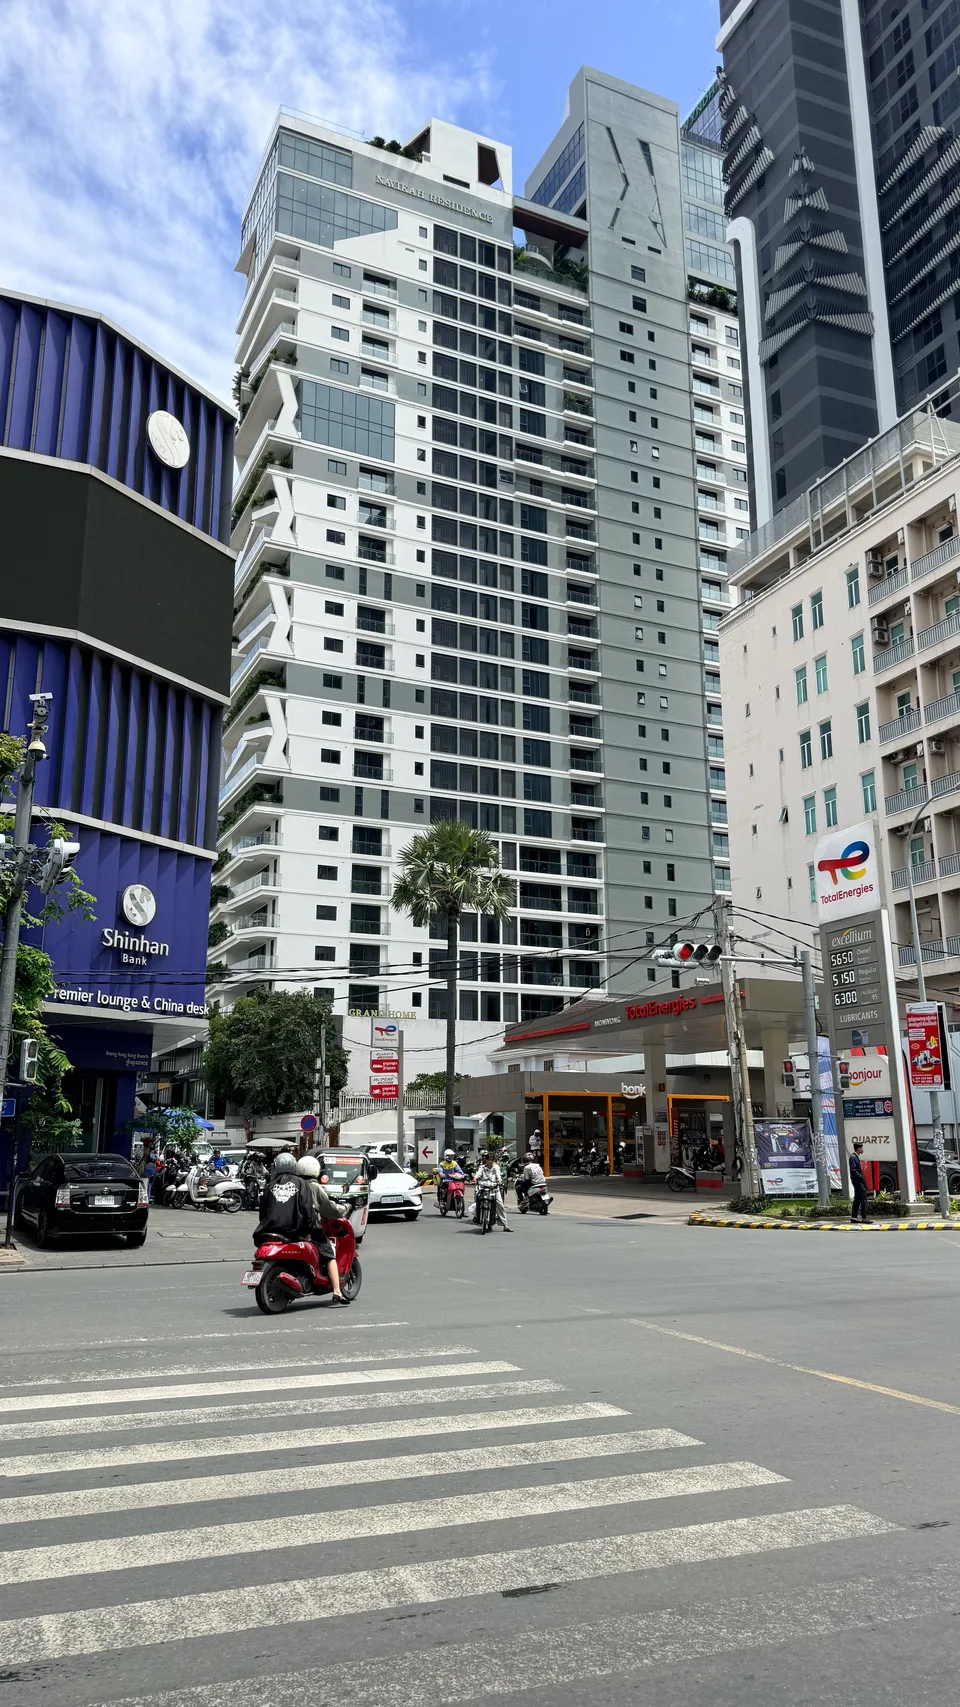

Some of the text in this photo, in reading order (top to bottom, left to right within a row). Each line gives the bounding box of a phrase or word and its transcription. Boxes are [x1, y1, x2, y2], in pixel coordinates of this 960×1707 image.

[429, 194, 493, 224] RESIDENCE
[820, 884, 873, 904] TotalEnergies
[101, 927, 169, 956] Shinhan
[831, 929, 872, 947] excellium
[122, 953, 147, 966] Bank
[831, 951, 853, 966] 5650
[832, 970, 855, 986] 5150
[45, 987, 210, 1015] remier lounge & China desk
[834, 990, 857, 1006] 6300
[389, 1011, 416, 1019] HOME
[624, 995, 696, 1019] TotalEnergies
[840, 1010, 878, 1023] LUBRICANTS
[621, 1082, 646, 1095] bonjo
[851, 1135, 890, 1144] QUARTZ
